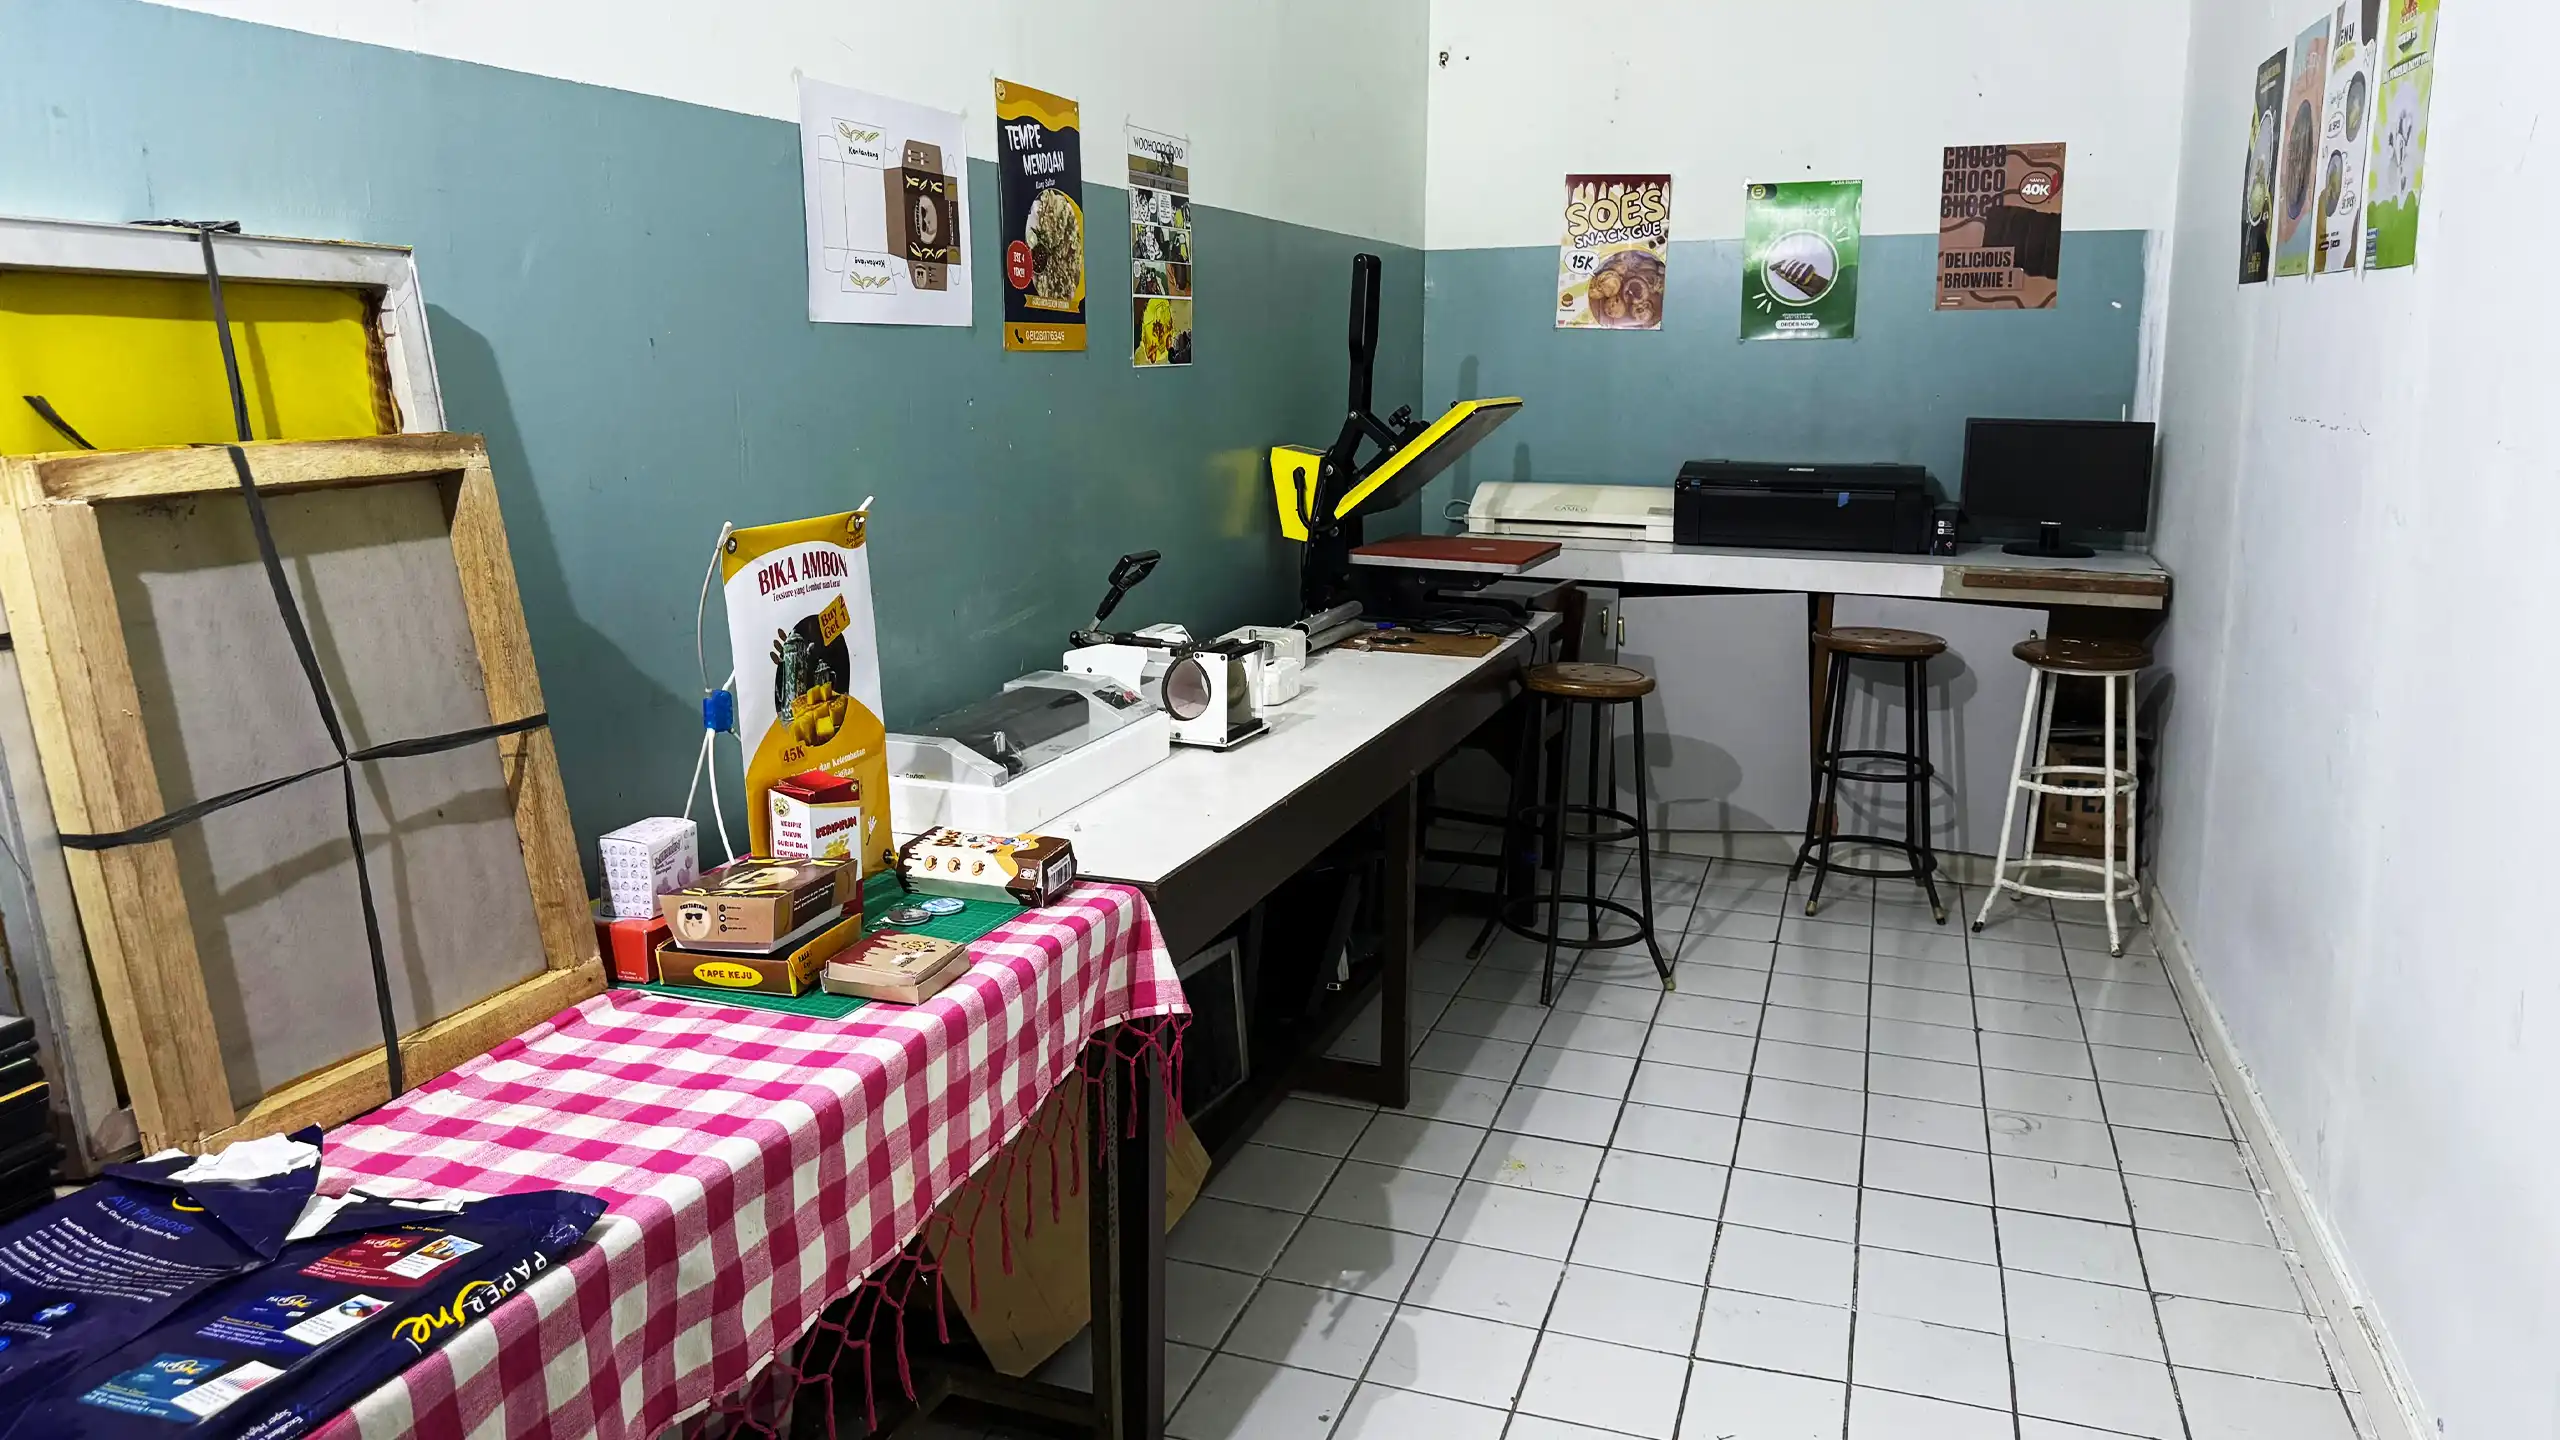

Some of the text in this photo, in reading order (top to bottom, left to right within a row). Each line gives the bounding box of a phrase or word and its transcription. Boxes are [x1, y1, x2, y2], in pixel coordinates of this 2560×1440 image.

[1004, 123, 1042, 151] TEMPE
[1022, 150, 1065, 176] MENDOAN
[1943, 144, 2007, 169] CHOCO
[1941, 169, 2006, 194] CHOCO
[2021, 184, 2050, 196] 40K
[1565, 188, 1666, 236] SOES
[1575, 222, 1661, 249] SNACK GUE
[1572, 254, 1594, 270] 15K
[1945, 251, 2012, 269] DELICIOUS
[1944, 272, 2004, 289] BROWNIE
[758, 551, 848, 596] BIKA AMBON
[821, 596, 846, 628] Buy 2
[823, 611, 846, 640] Get 1
[783, 744, 805, 763] 45K
[699, 968, 753, 980] TAPE KEJU
[107, 1195, 195, 1235] All Purpose
[108, 1210, 121, 1220] One
